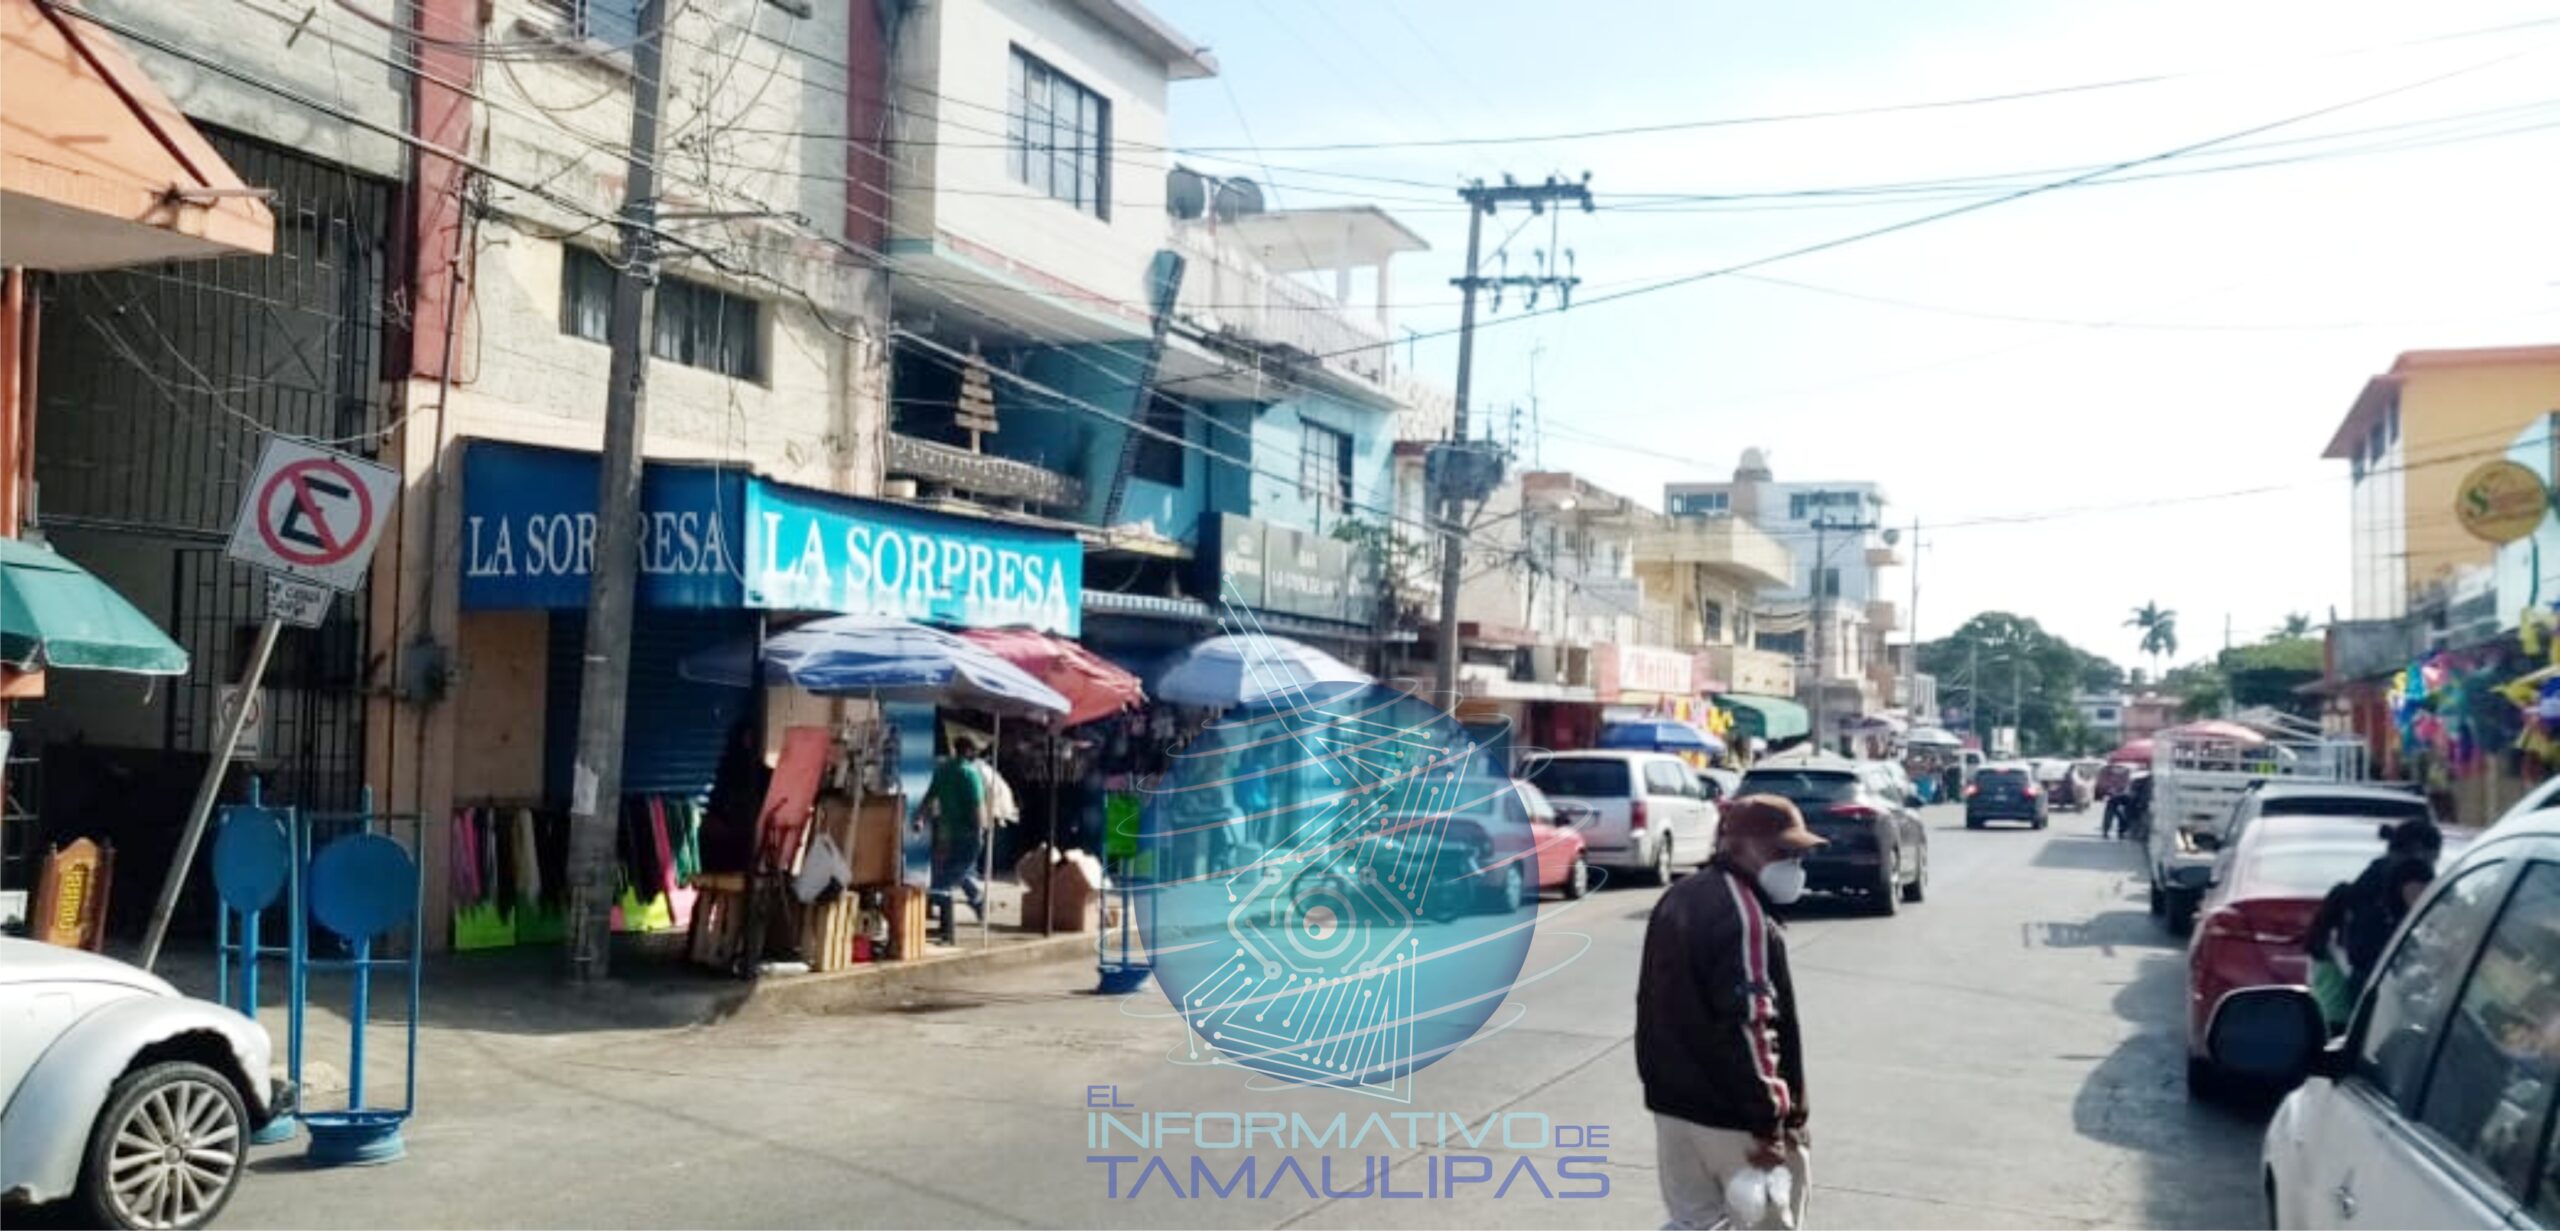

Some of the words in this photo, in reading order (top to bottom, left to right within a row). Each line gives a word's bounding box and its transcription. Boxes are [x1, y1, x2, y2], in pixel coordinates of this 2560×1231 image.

[467, 514, 517, 576] LA
[763, 511, 833, 586] LA
[845, 525, 1071, 620] SORPRESA
